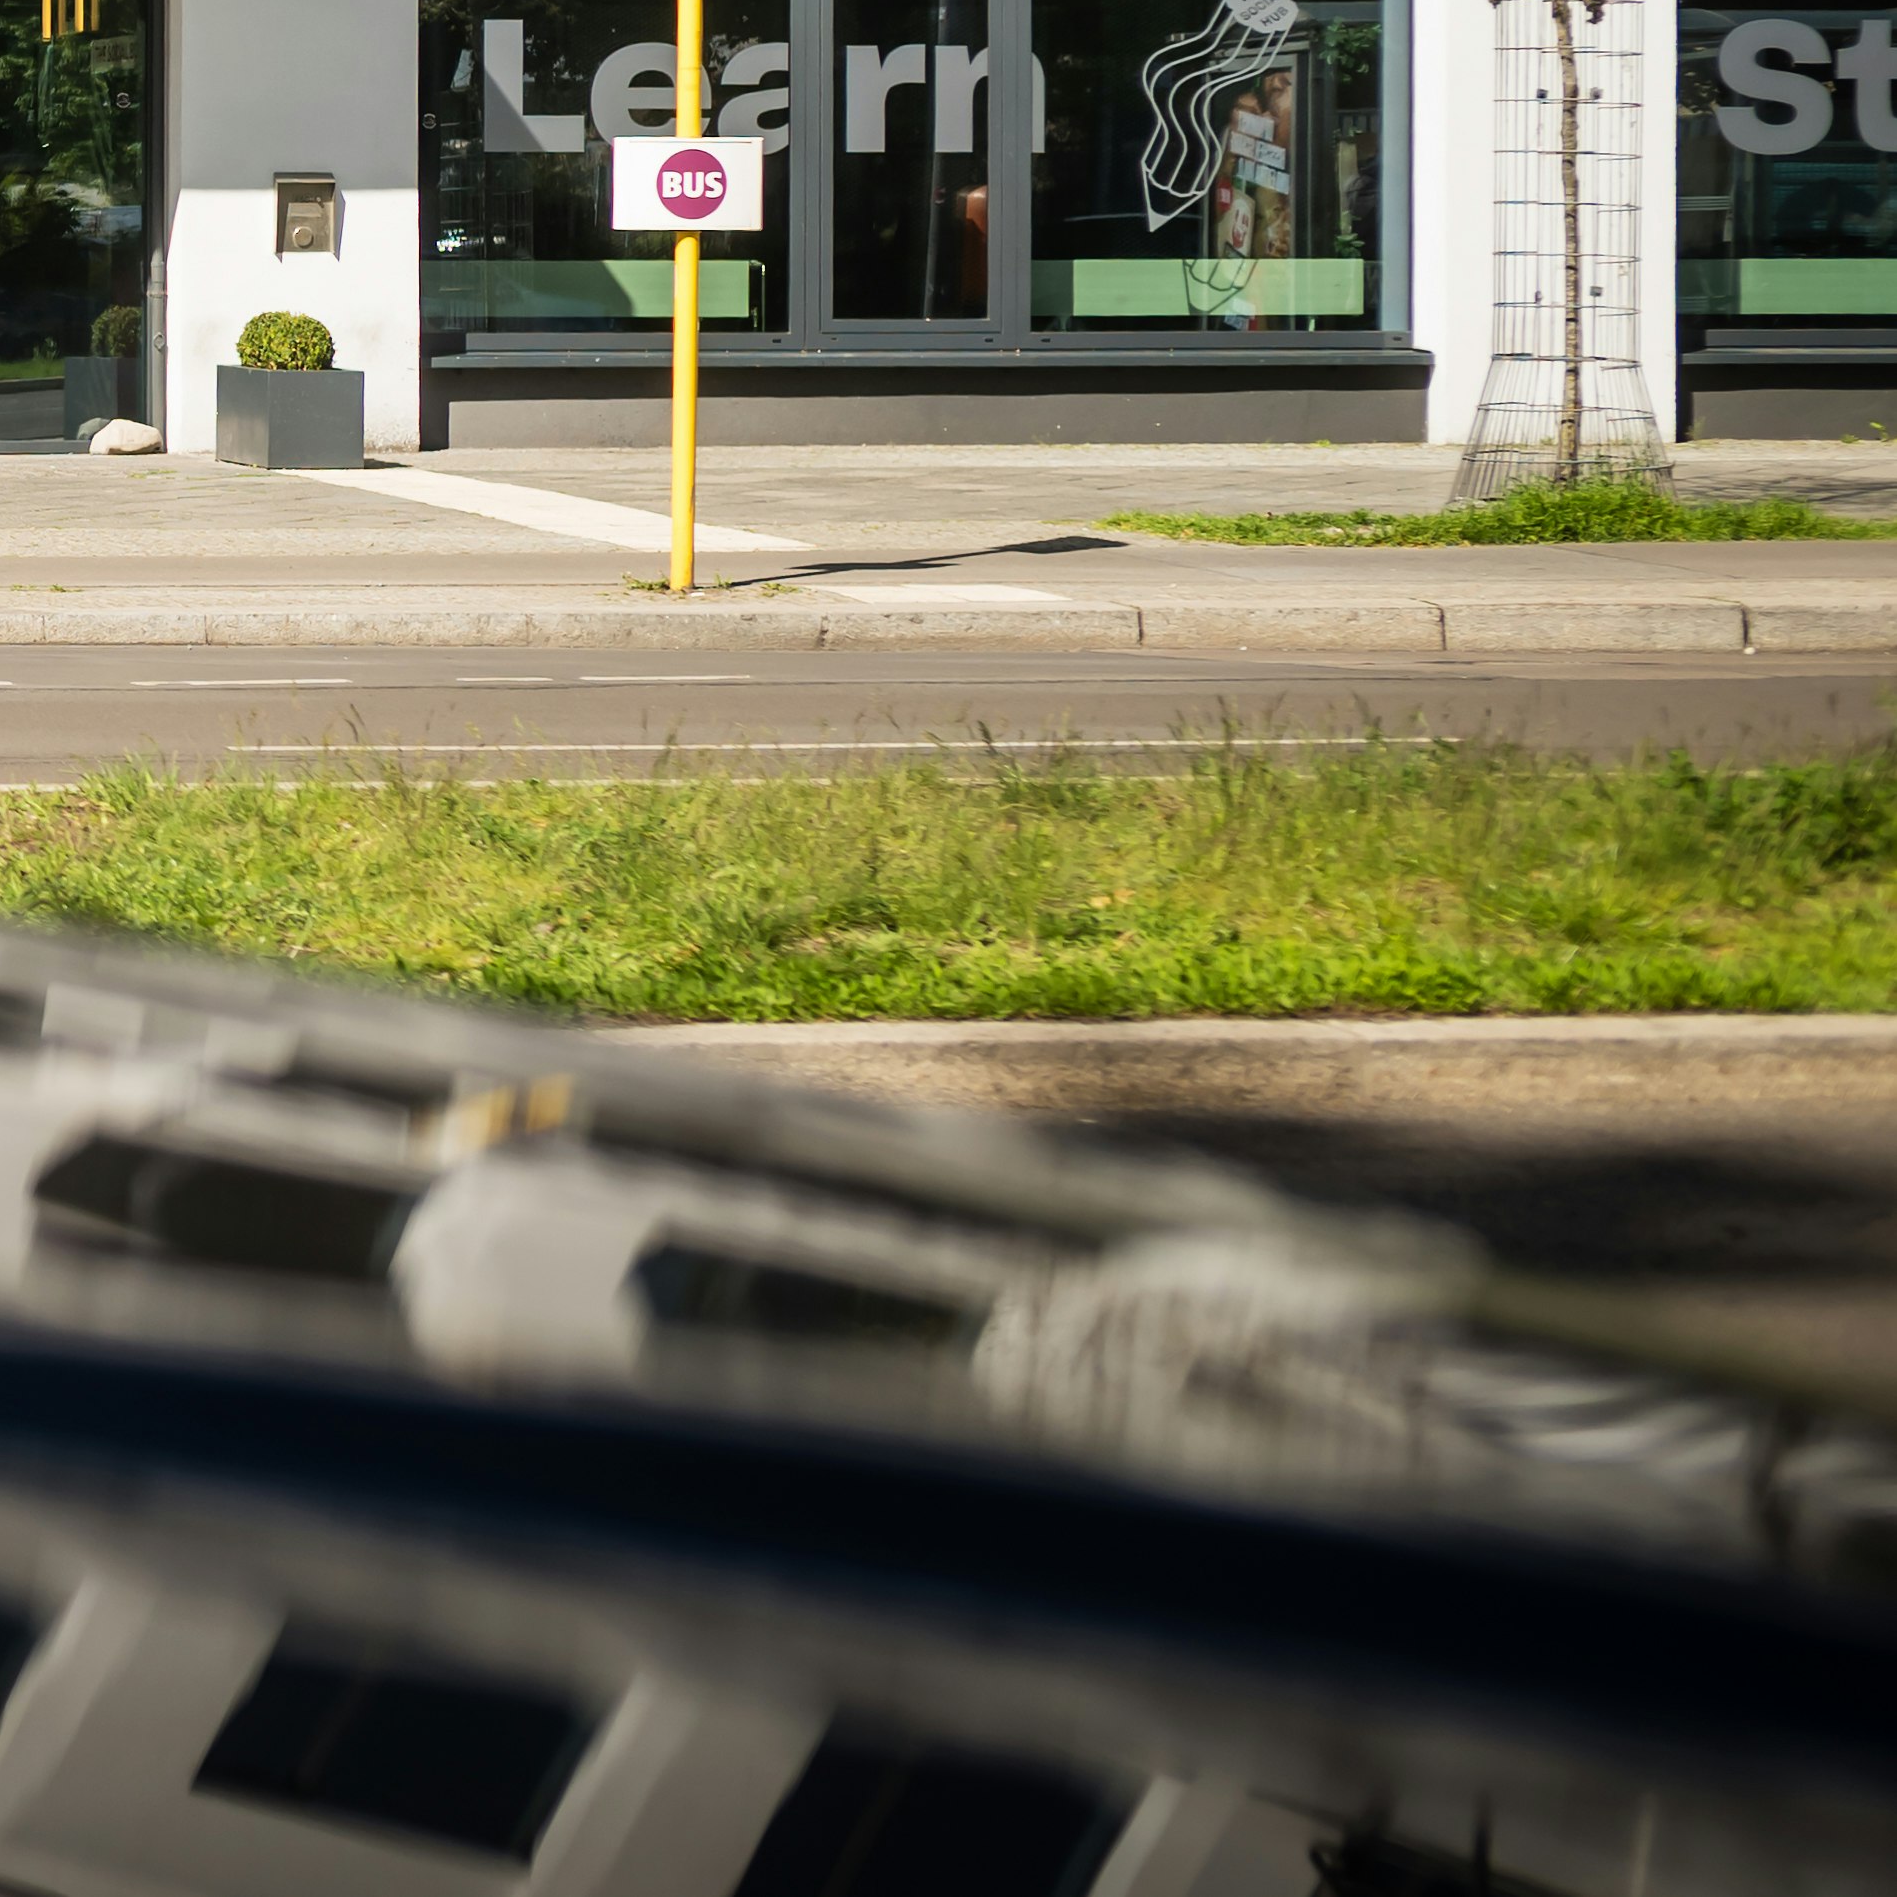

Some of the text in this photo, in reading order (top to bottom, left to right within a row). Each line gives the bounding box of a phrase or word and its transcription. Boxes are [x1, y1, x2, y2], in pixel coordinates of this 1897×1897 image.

[1260, 6, 1289, 27] HUB
[484, 19, 1046, 155] Learn
[1717, 18, 1897, 156] St
[661, 171, 724, 199] BUS
